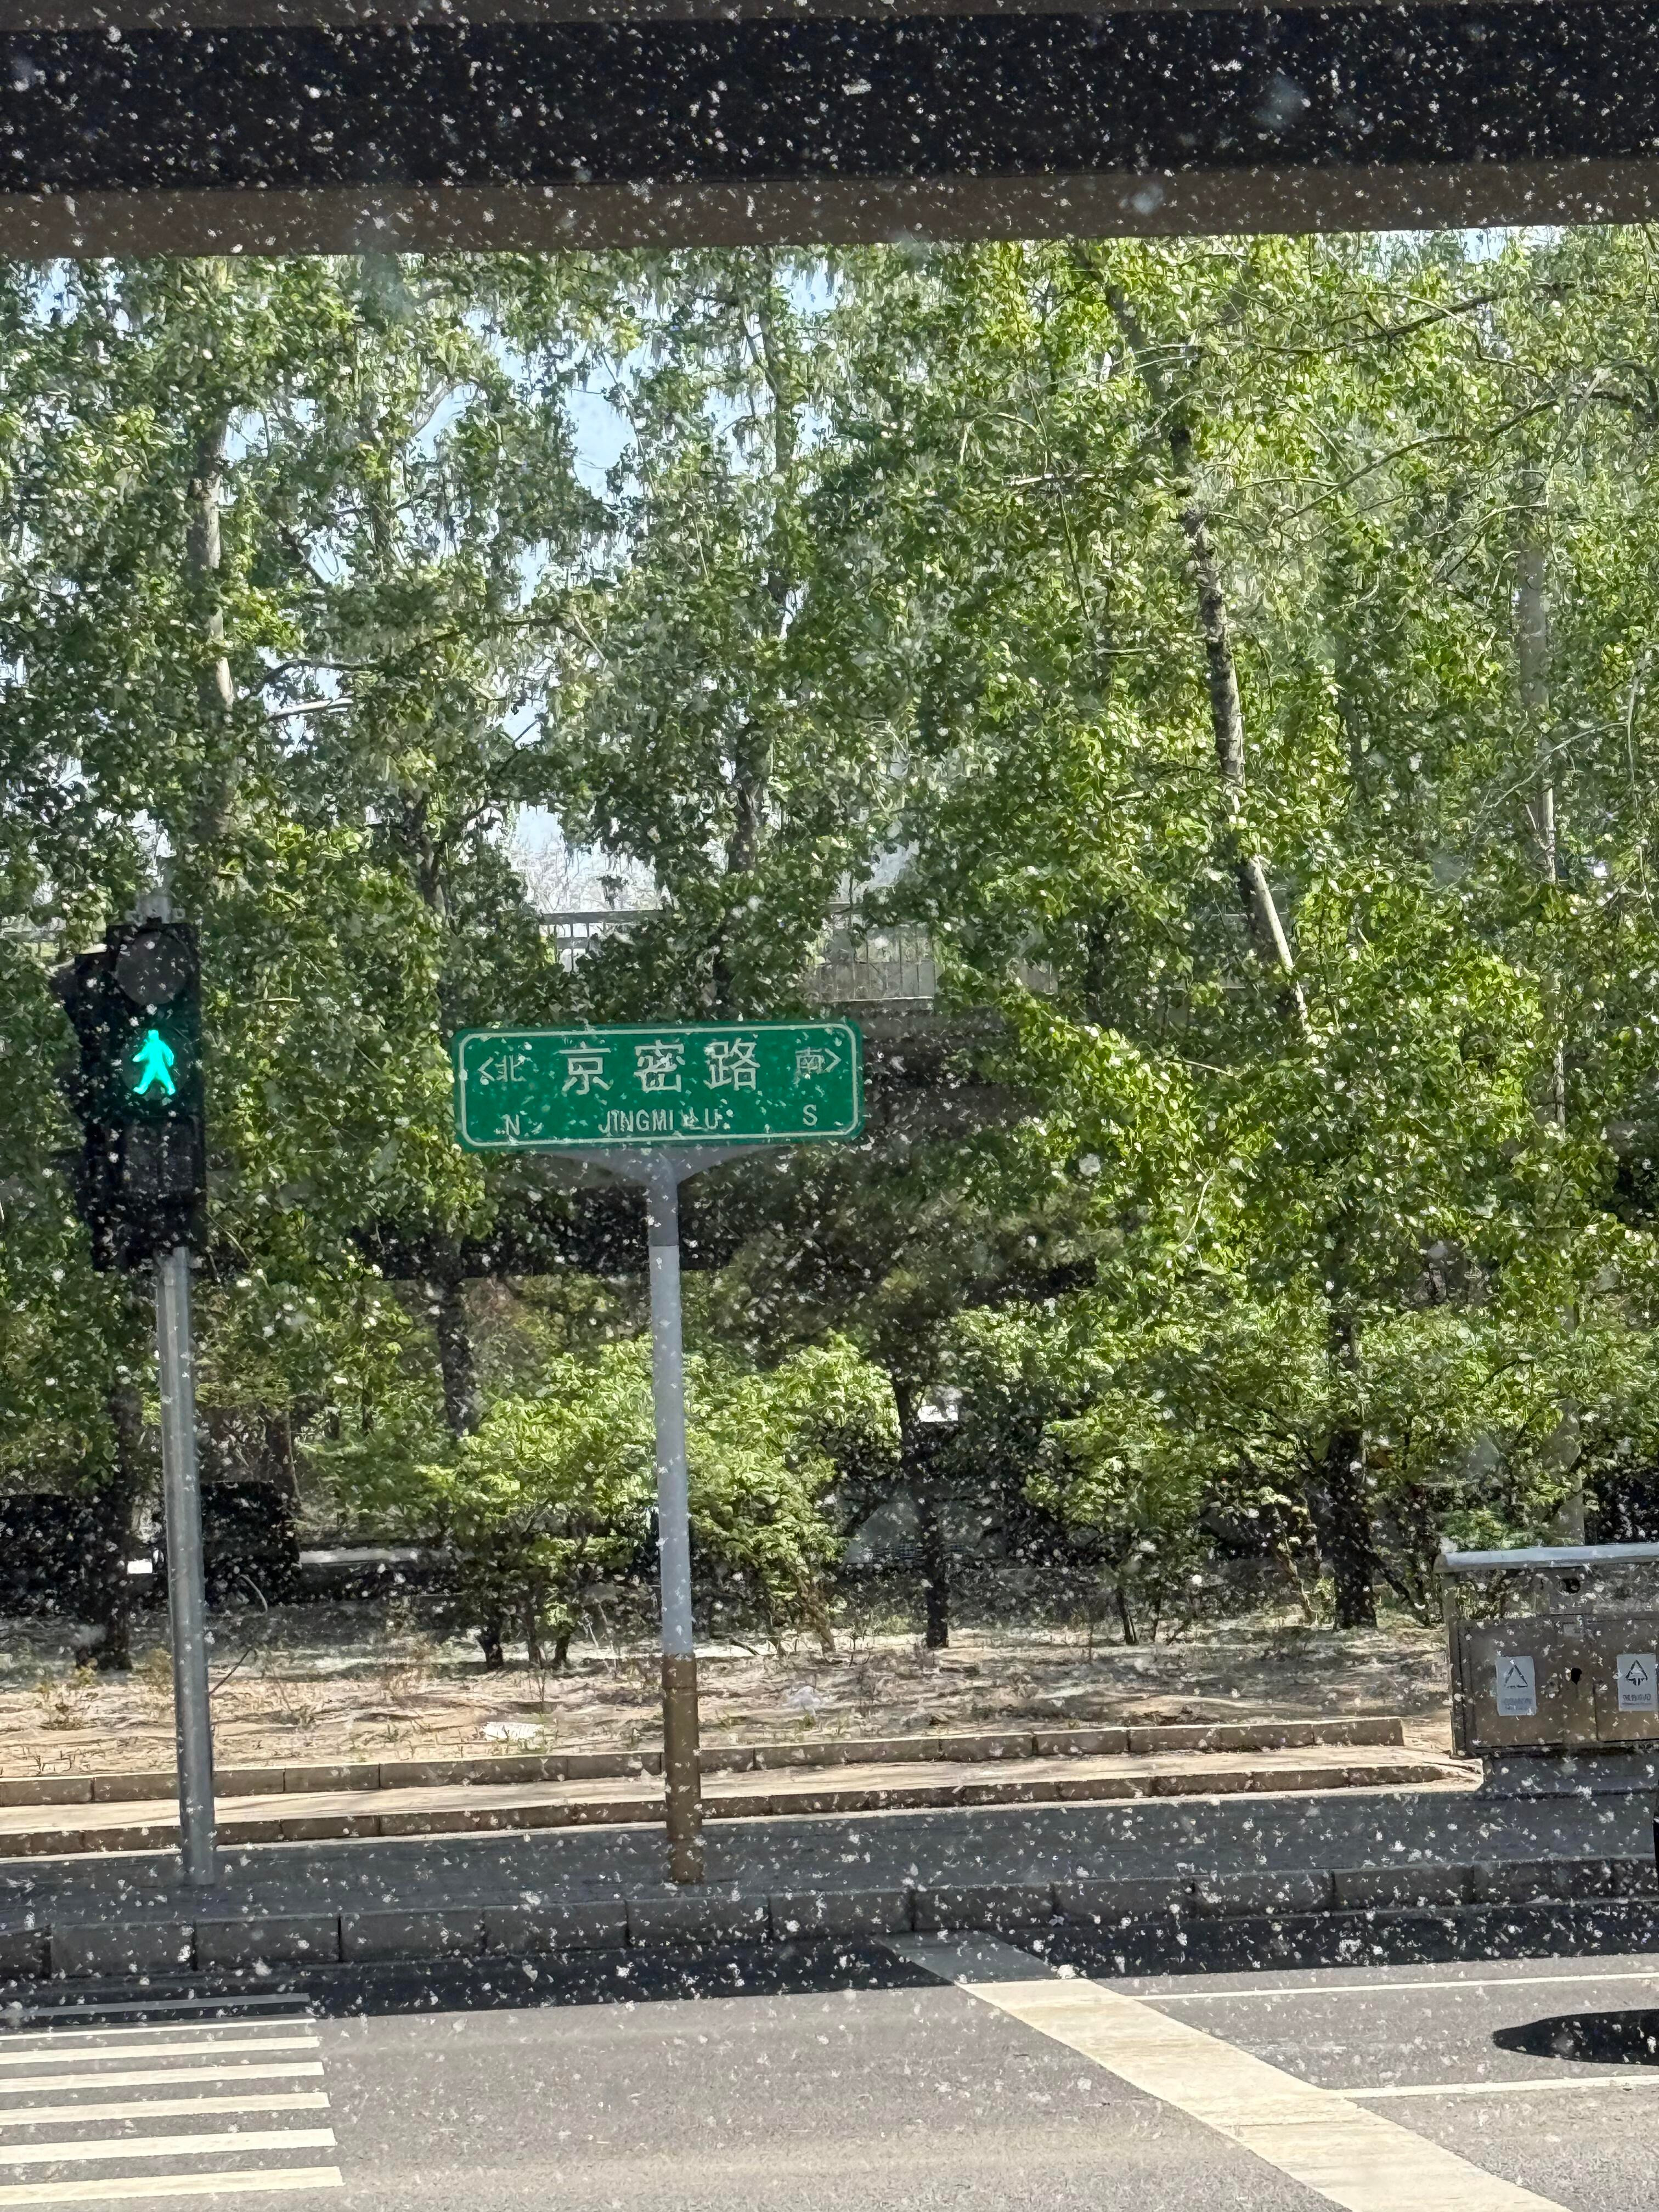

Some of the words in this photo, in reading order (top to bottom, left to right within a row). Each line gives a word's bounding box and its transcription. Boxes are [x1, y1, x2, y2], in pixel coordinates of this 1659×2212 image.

[494, 1054, 527, 1082] 北
[558, 1039, 761, 1095] 京密路
[795, 1047, 823, 1074] 南
[504, 1114, 520, 1136] N
[598, 1109, 674, 1133] JINGMI
[803, 1104, 818, 1126] S
